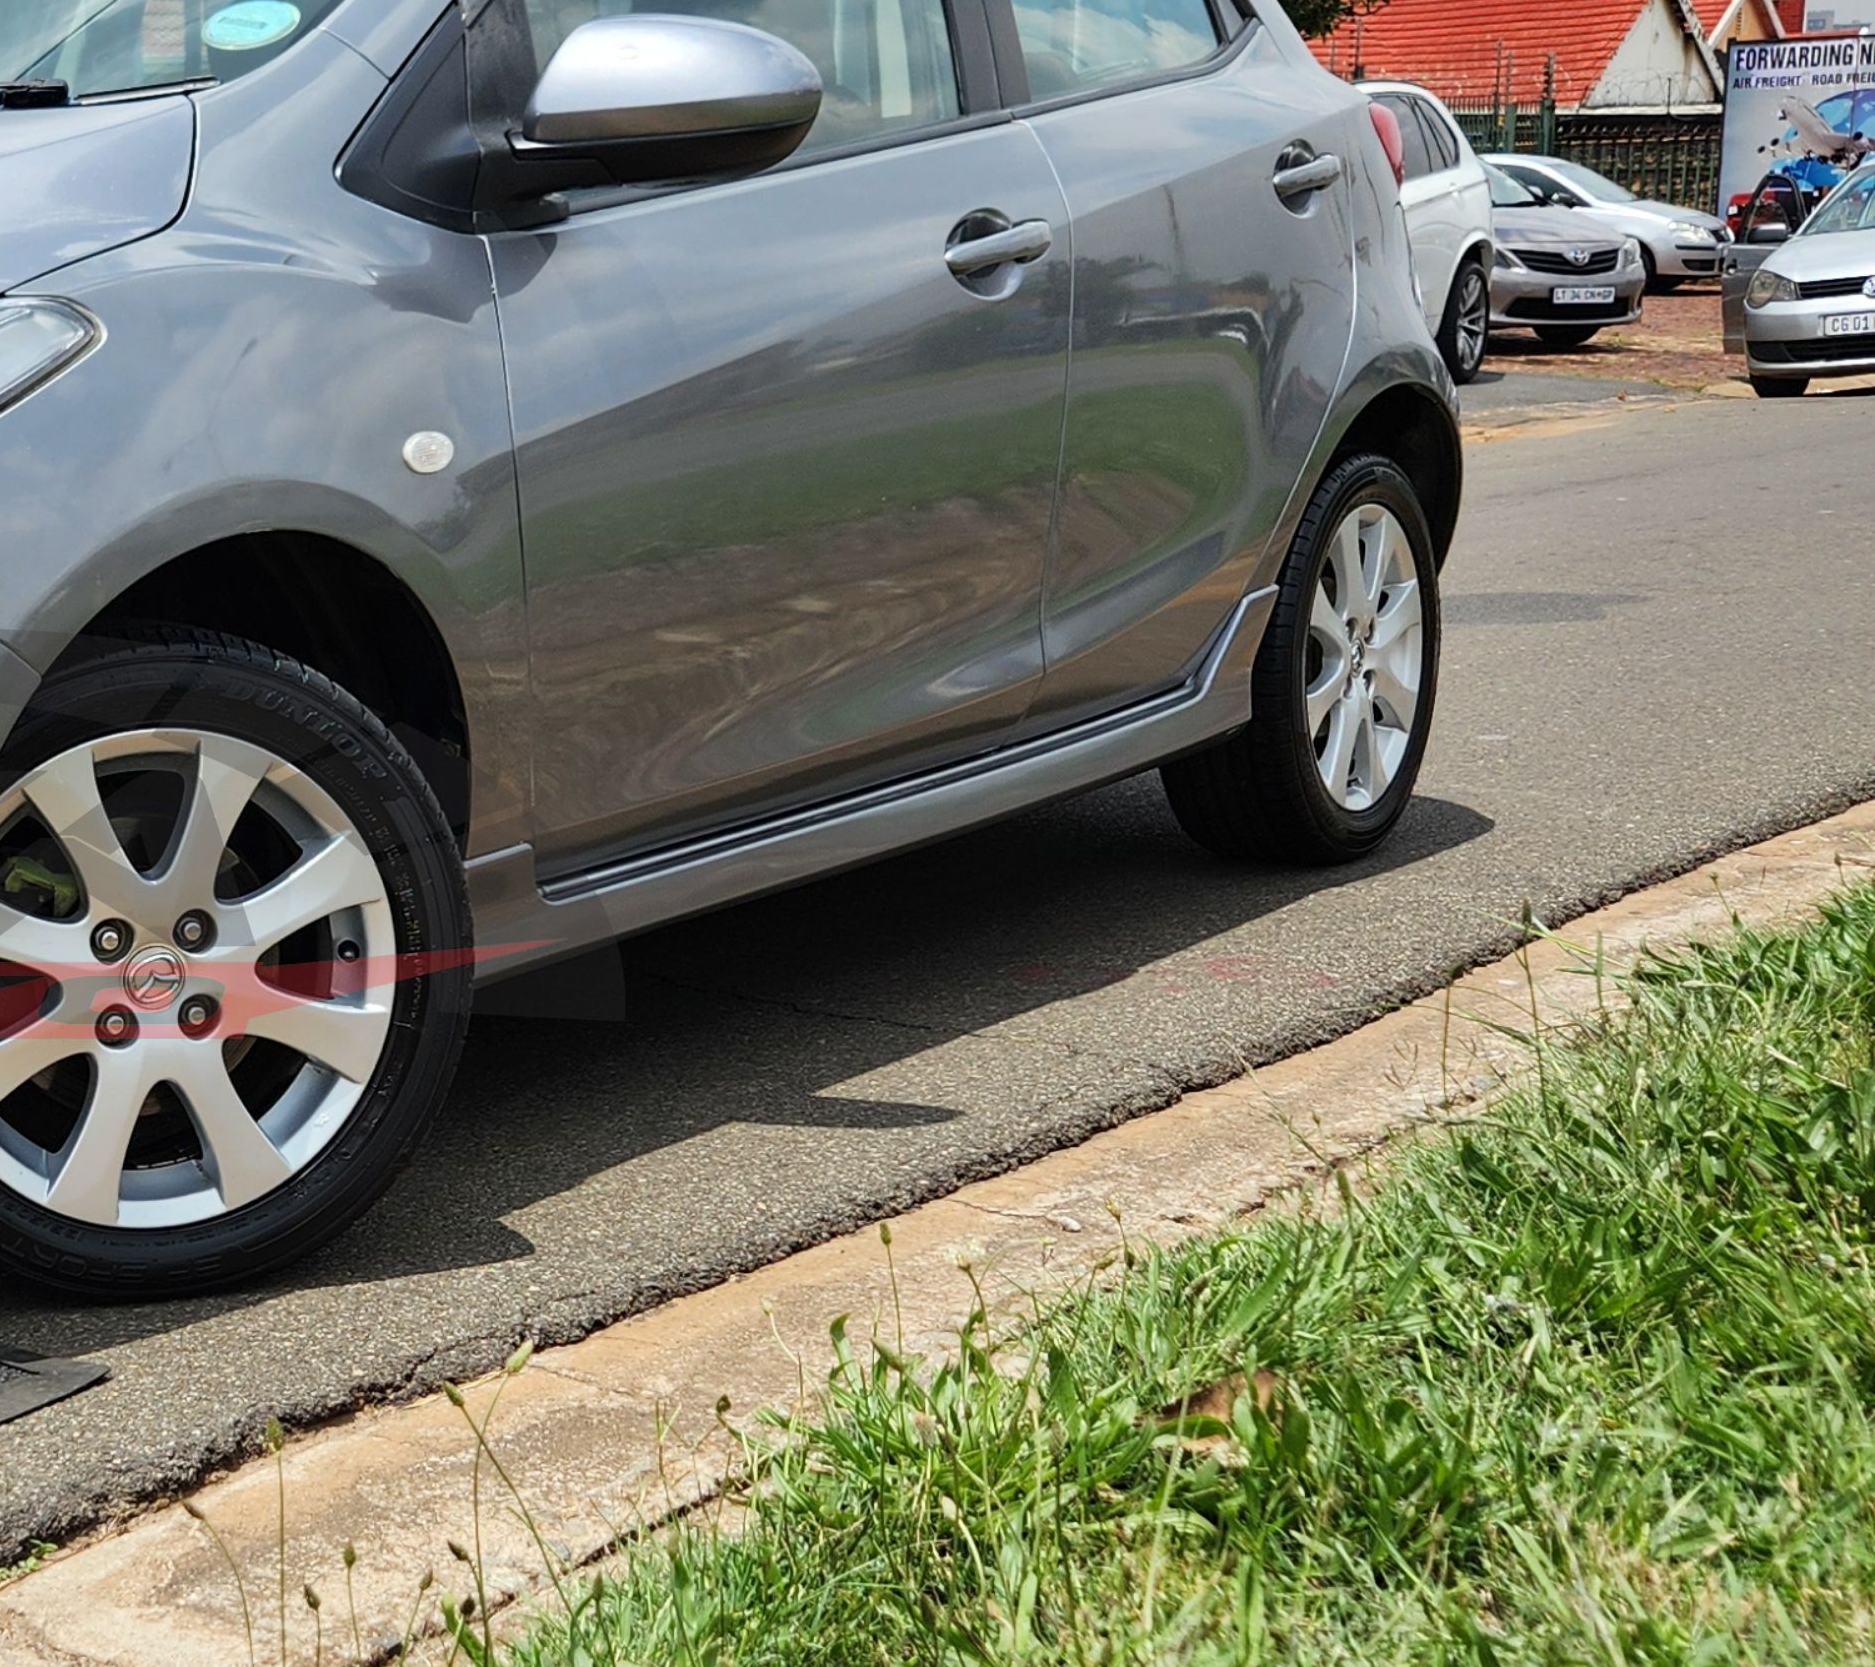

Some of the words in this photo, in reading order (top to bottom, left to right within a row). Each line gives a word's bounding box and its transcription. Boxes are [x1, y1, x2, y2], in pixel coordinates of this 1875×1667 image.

[1735, 43, 1855, 72] FORWARDING
[1860, 42, 1875, 65] N
[1732, 77, 1752, 90] AIR
[1755, 75, 1802, 89] FREIGHT
[1812, 72, 1842, 86] ROAD
[218, 675, 390, 780] DUNLOP
